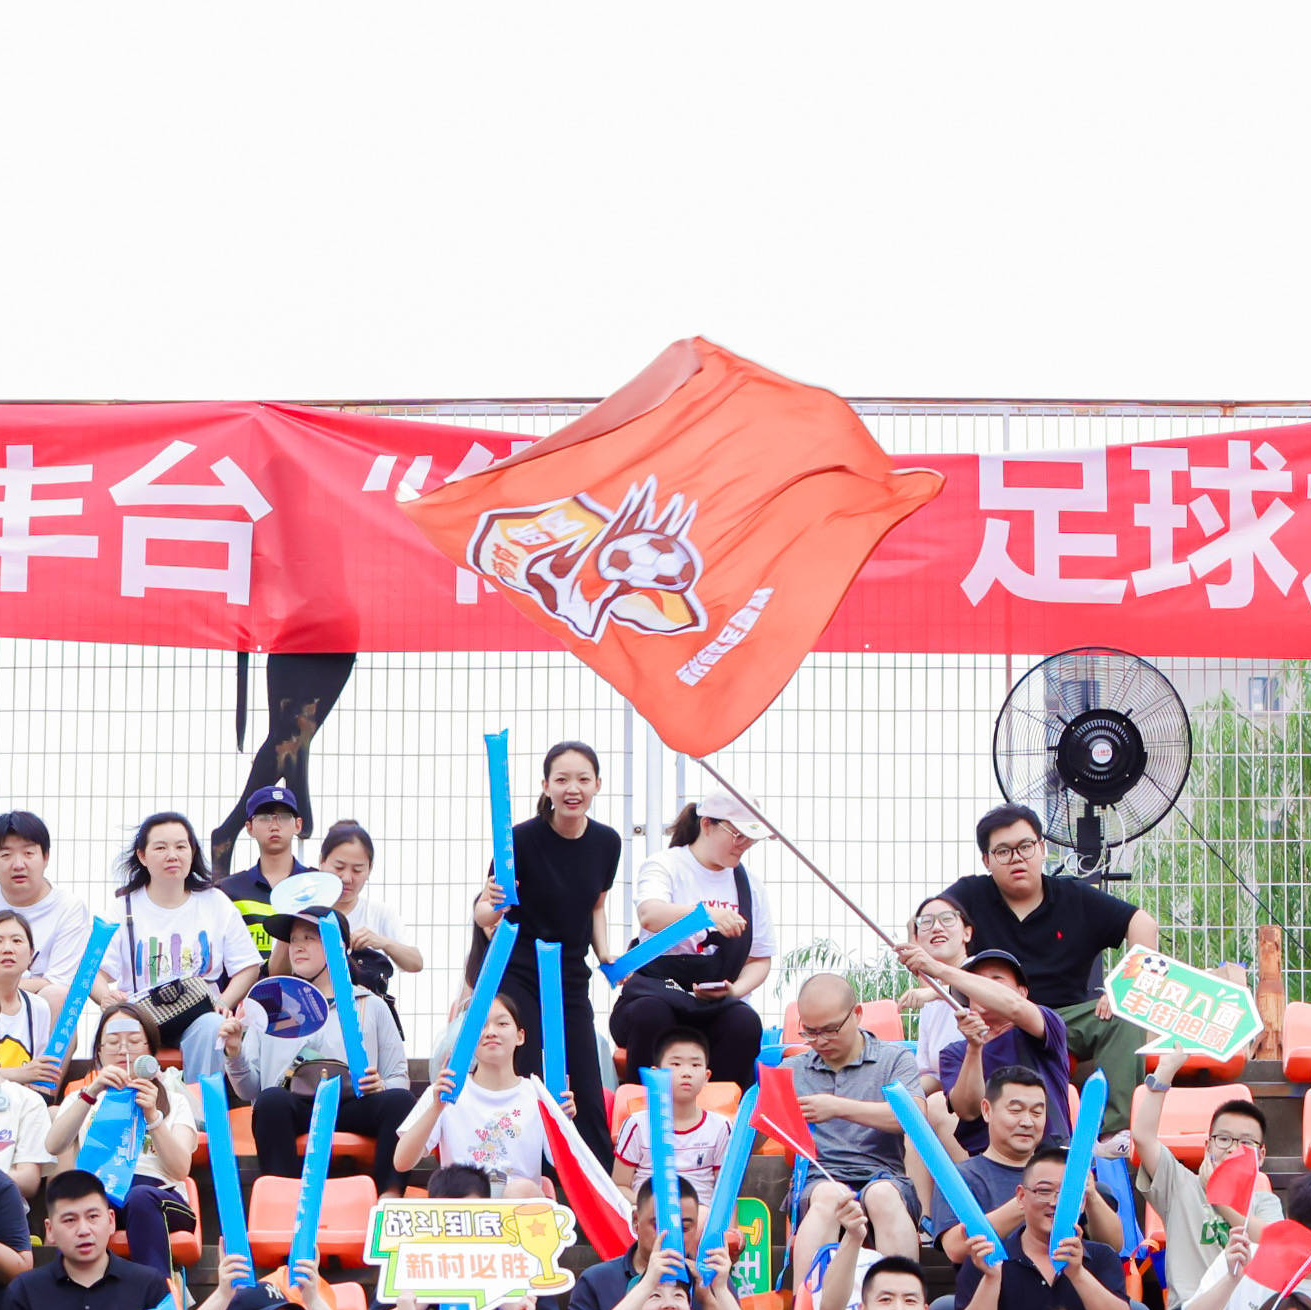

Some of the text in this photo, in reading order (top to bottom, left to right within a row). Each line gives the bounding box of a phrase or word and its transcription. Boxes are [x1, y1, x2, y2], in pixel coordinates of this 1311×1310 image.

[1132, 969, 1247, 1031] 威风八面
[385, 1209, 504, 1238] 战斗到底
[406, 1252, 530, 1281] 新村必胜
